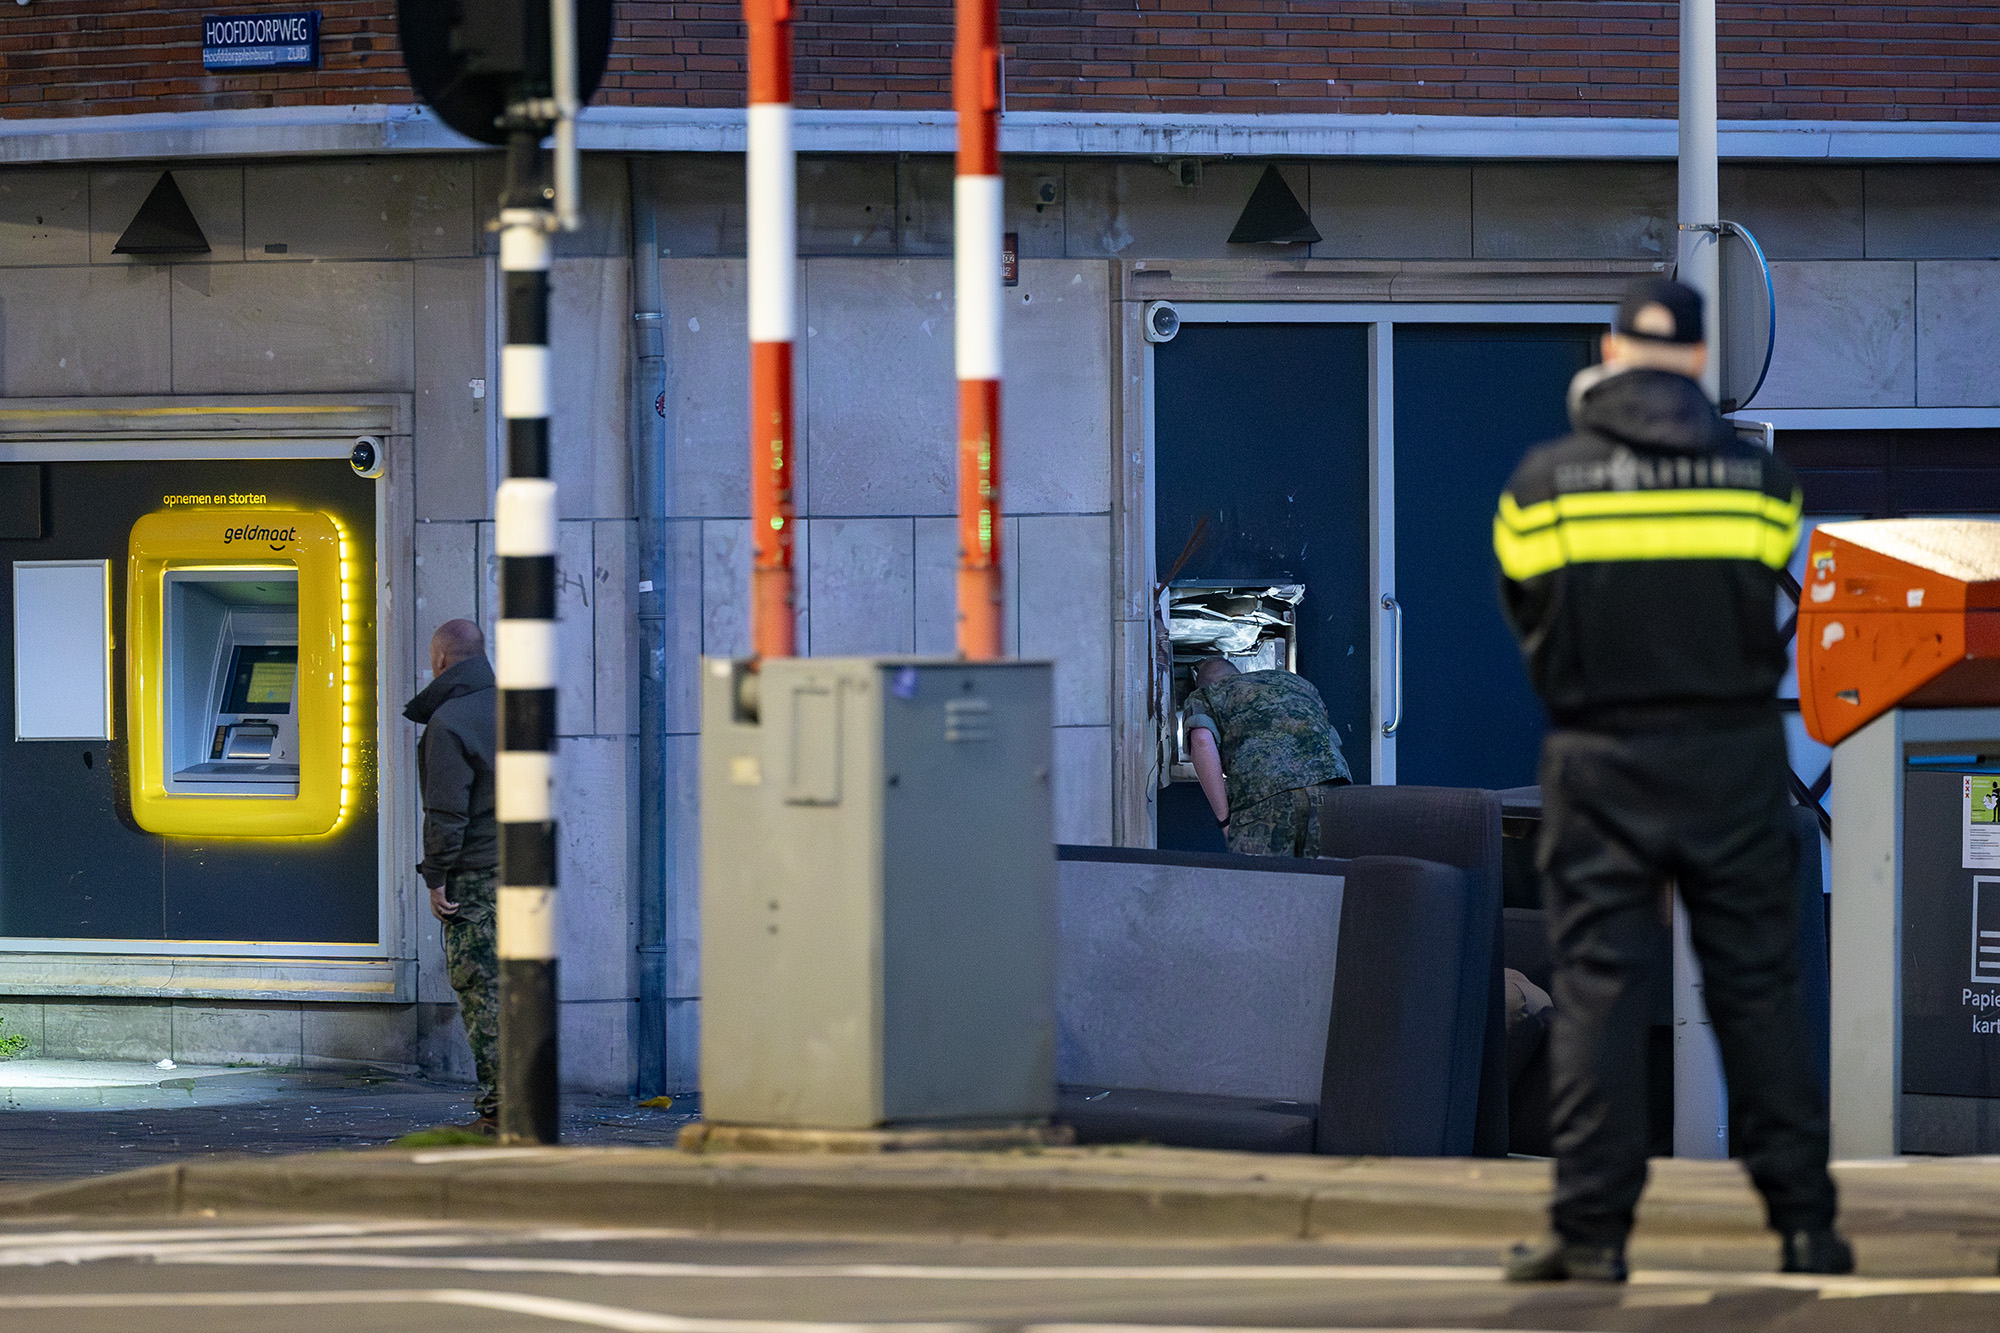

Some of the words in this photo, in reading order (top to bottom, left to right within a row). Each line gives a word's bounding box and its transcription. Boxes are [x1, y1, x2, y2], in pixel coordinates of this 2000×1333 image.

[206, 18, 307, 45] HOOFDDORPWEG
[287, 47, 308, 60] ZUID
[163, 494, 211, 508] opnemen
[213, 494, 227, 504] en
[228, 492, 267, 504] storten
[223, 524, 296, 544] geldmaat
